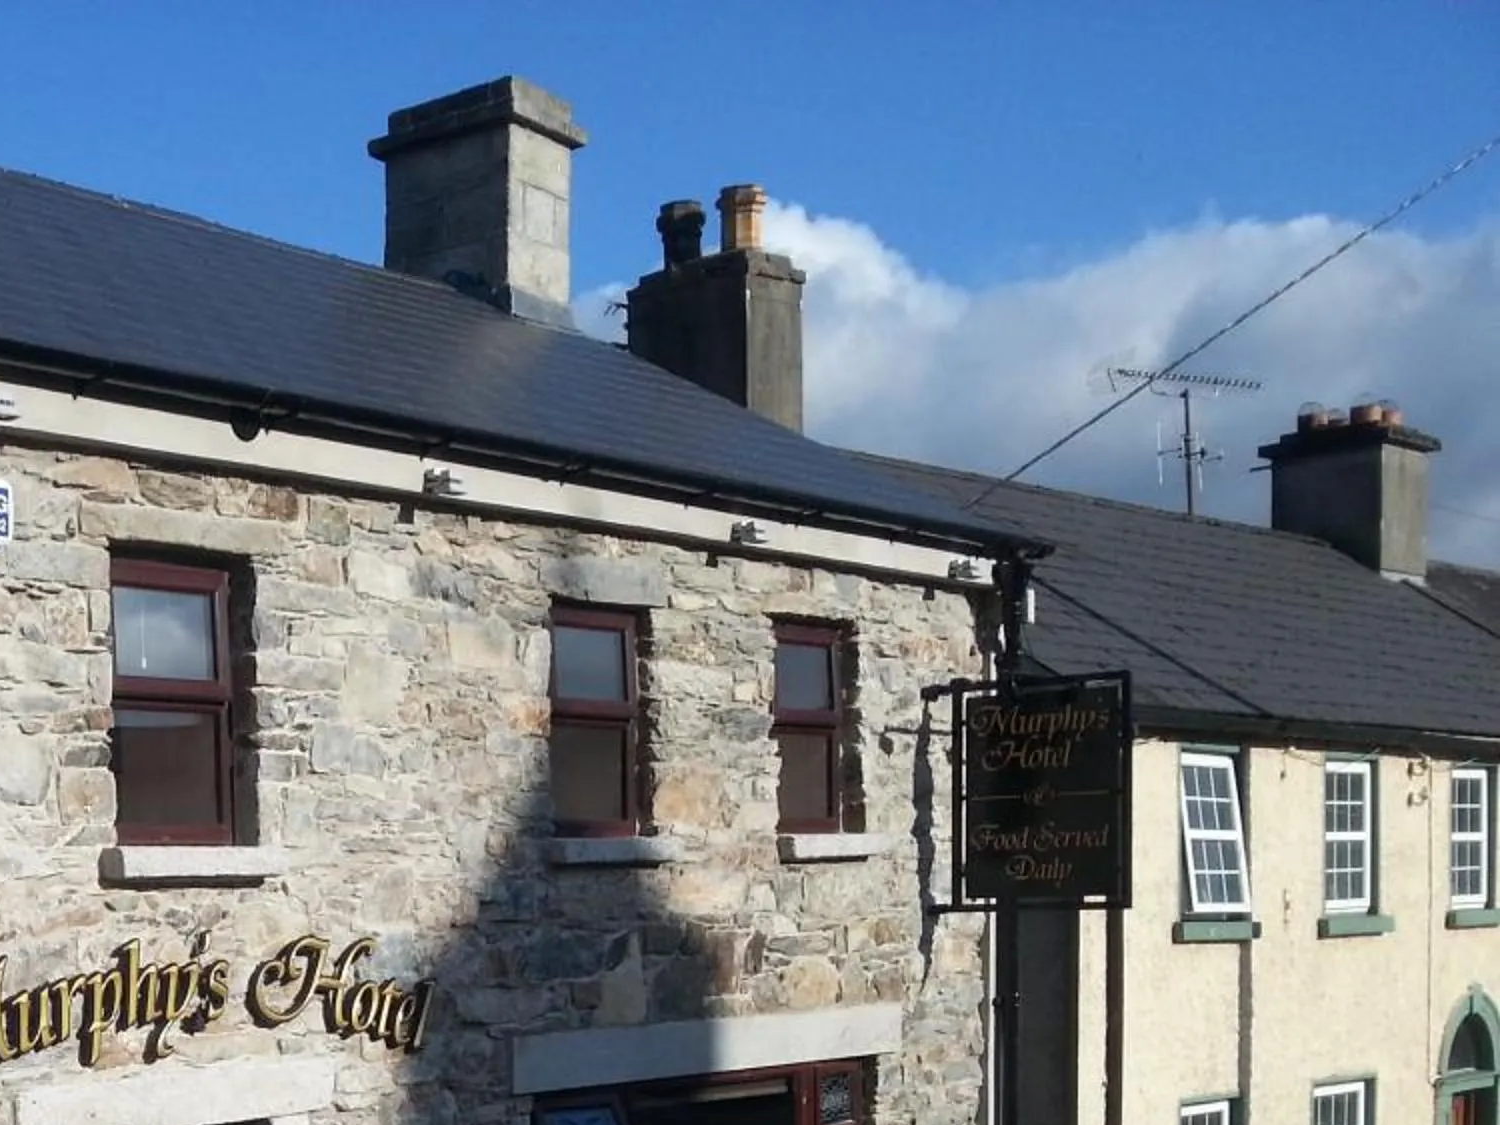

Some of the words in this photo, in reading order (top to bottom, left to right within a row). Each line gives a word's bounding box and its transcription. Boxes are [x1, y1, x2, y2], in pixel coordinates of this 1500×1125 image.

[982, 737, 1071, 771] Hotel
[971, 824, 1029, 851] Food
[1034, 821, 1109, 851] Served
[248, 934, 436, 1052] Hotel
